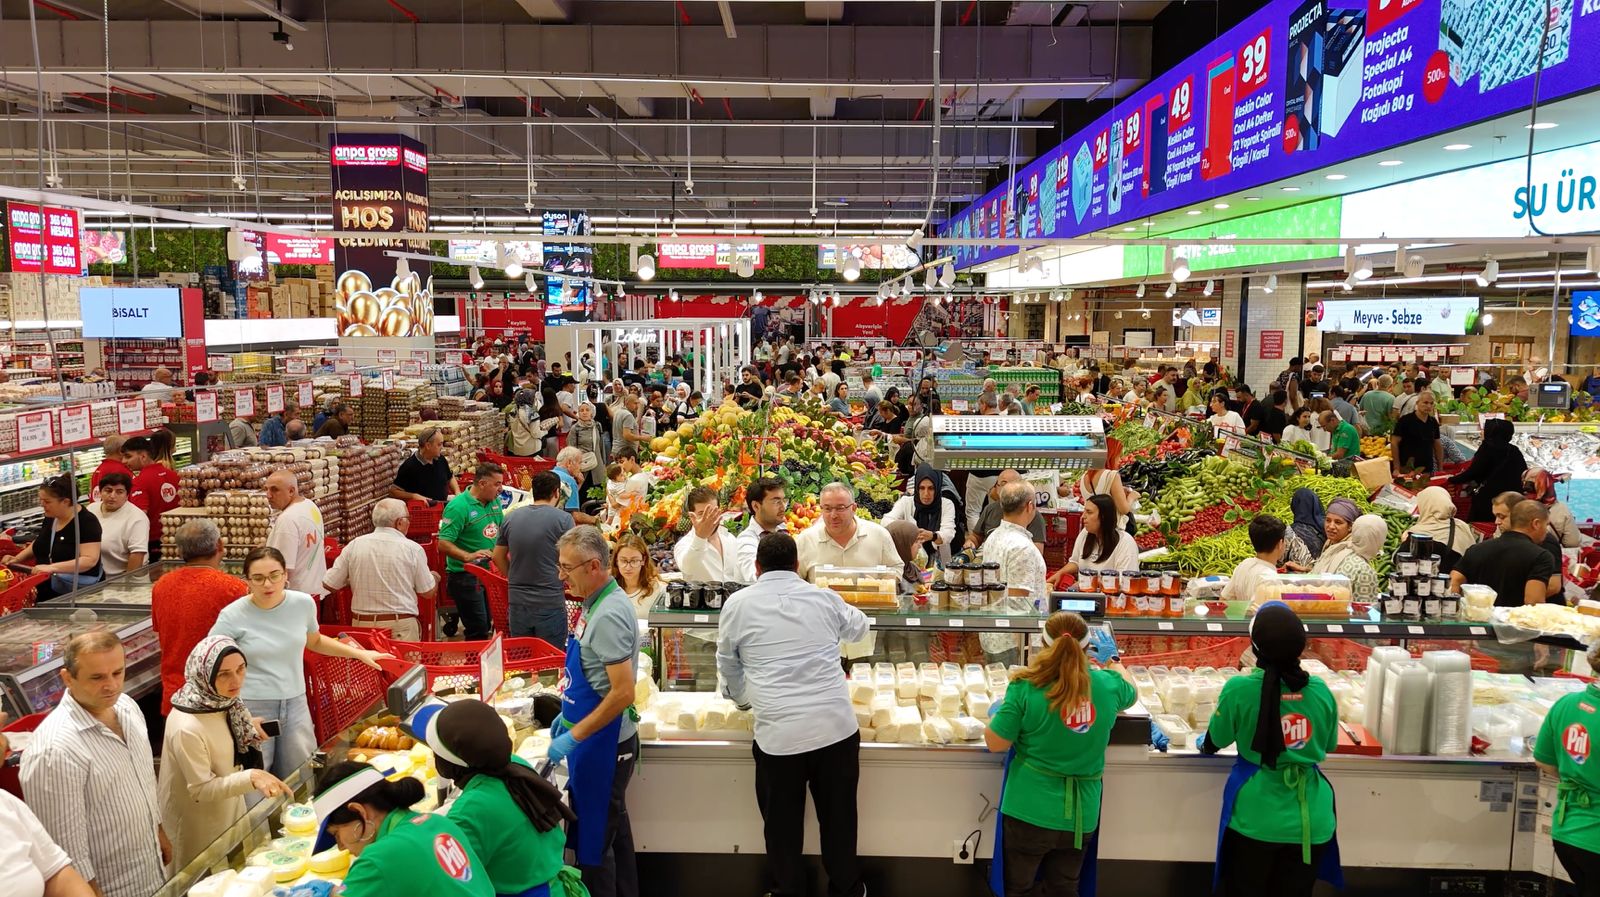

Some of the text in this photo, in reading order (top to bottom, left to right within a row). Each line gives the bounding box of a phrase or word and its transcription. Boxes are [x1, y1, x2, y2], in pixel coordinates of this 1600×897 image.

[1290, 2, 1322, 39] PROJECTA
[1365, 26, 1409, 58] Projecta
[1242, 35, 1266, 82] 39
[1364, 46, 1413, 80] Special A4
[1172, 82, 1189, 118] 49
[1362, 71, 1404, 102] Fotokopi
[1234, 99, 1254, 119] Keskin
[1256, 92, 1273, 110] Color
[1361, 94, 1414, 123] Kağıdı 80 g
[1126, 112, 1140, 144] 59
[1168, 126, 1195, 146] Keskin Color
[1234, 111, 1274, 135] Cool A4 Defter
[1096, 131, 1107, 162] 24
[1233, 122, 1282, 152] 72 Yaprak Spiralli
[335, 147, 398, 161] anpa gross
[1167, 148, 1176, 160] Cool
[1182, 142, 1195, 154] Defter
[1232, 153, 1249, 170] Çizgili
[1252, 144, 1270, 161] Kareli
[1057, 155, 1068, 182] 119
[1030, 174, 1038, 195] 99
[1513, 182, 1548, 219] SU
[543, 212, 567, 221] dyson
[689, 244, 715, 256] gross
[1354, 310, 1383, 328] Meyve
[1392, 308, 1422, 325] Sebze
[615, 328, 656, 343] Lokum
[1281, 718, 1307, 740] Pril
[1566, 726, 1588, 754] Pril
[437, 838, 466, 876] Pril
